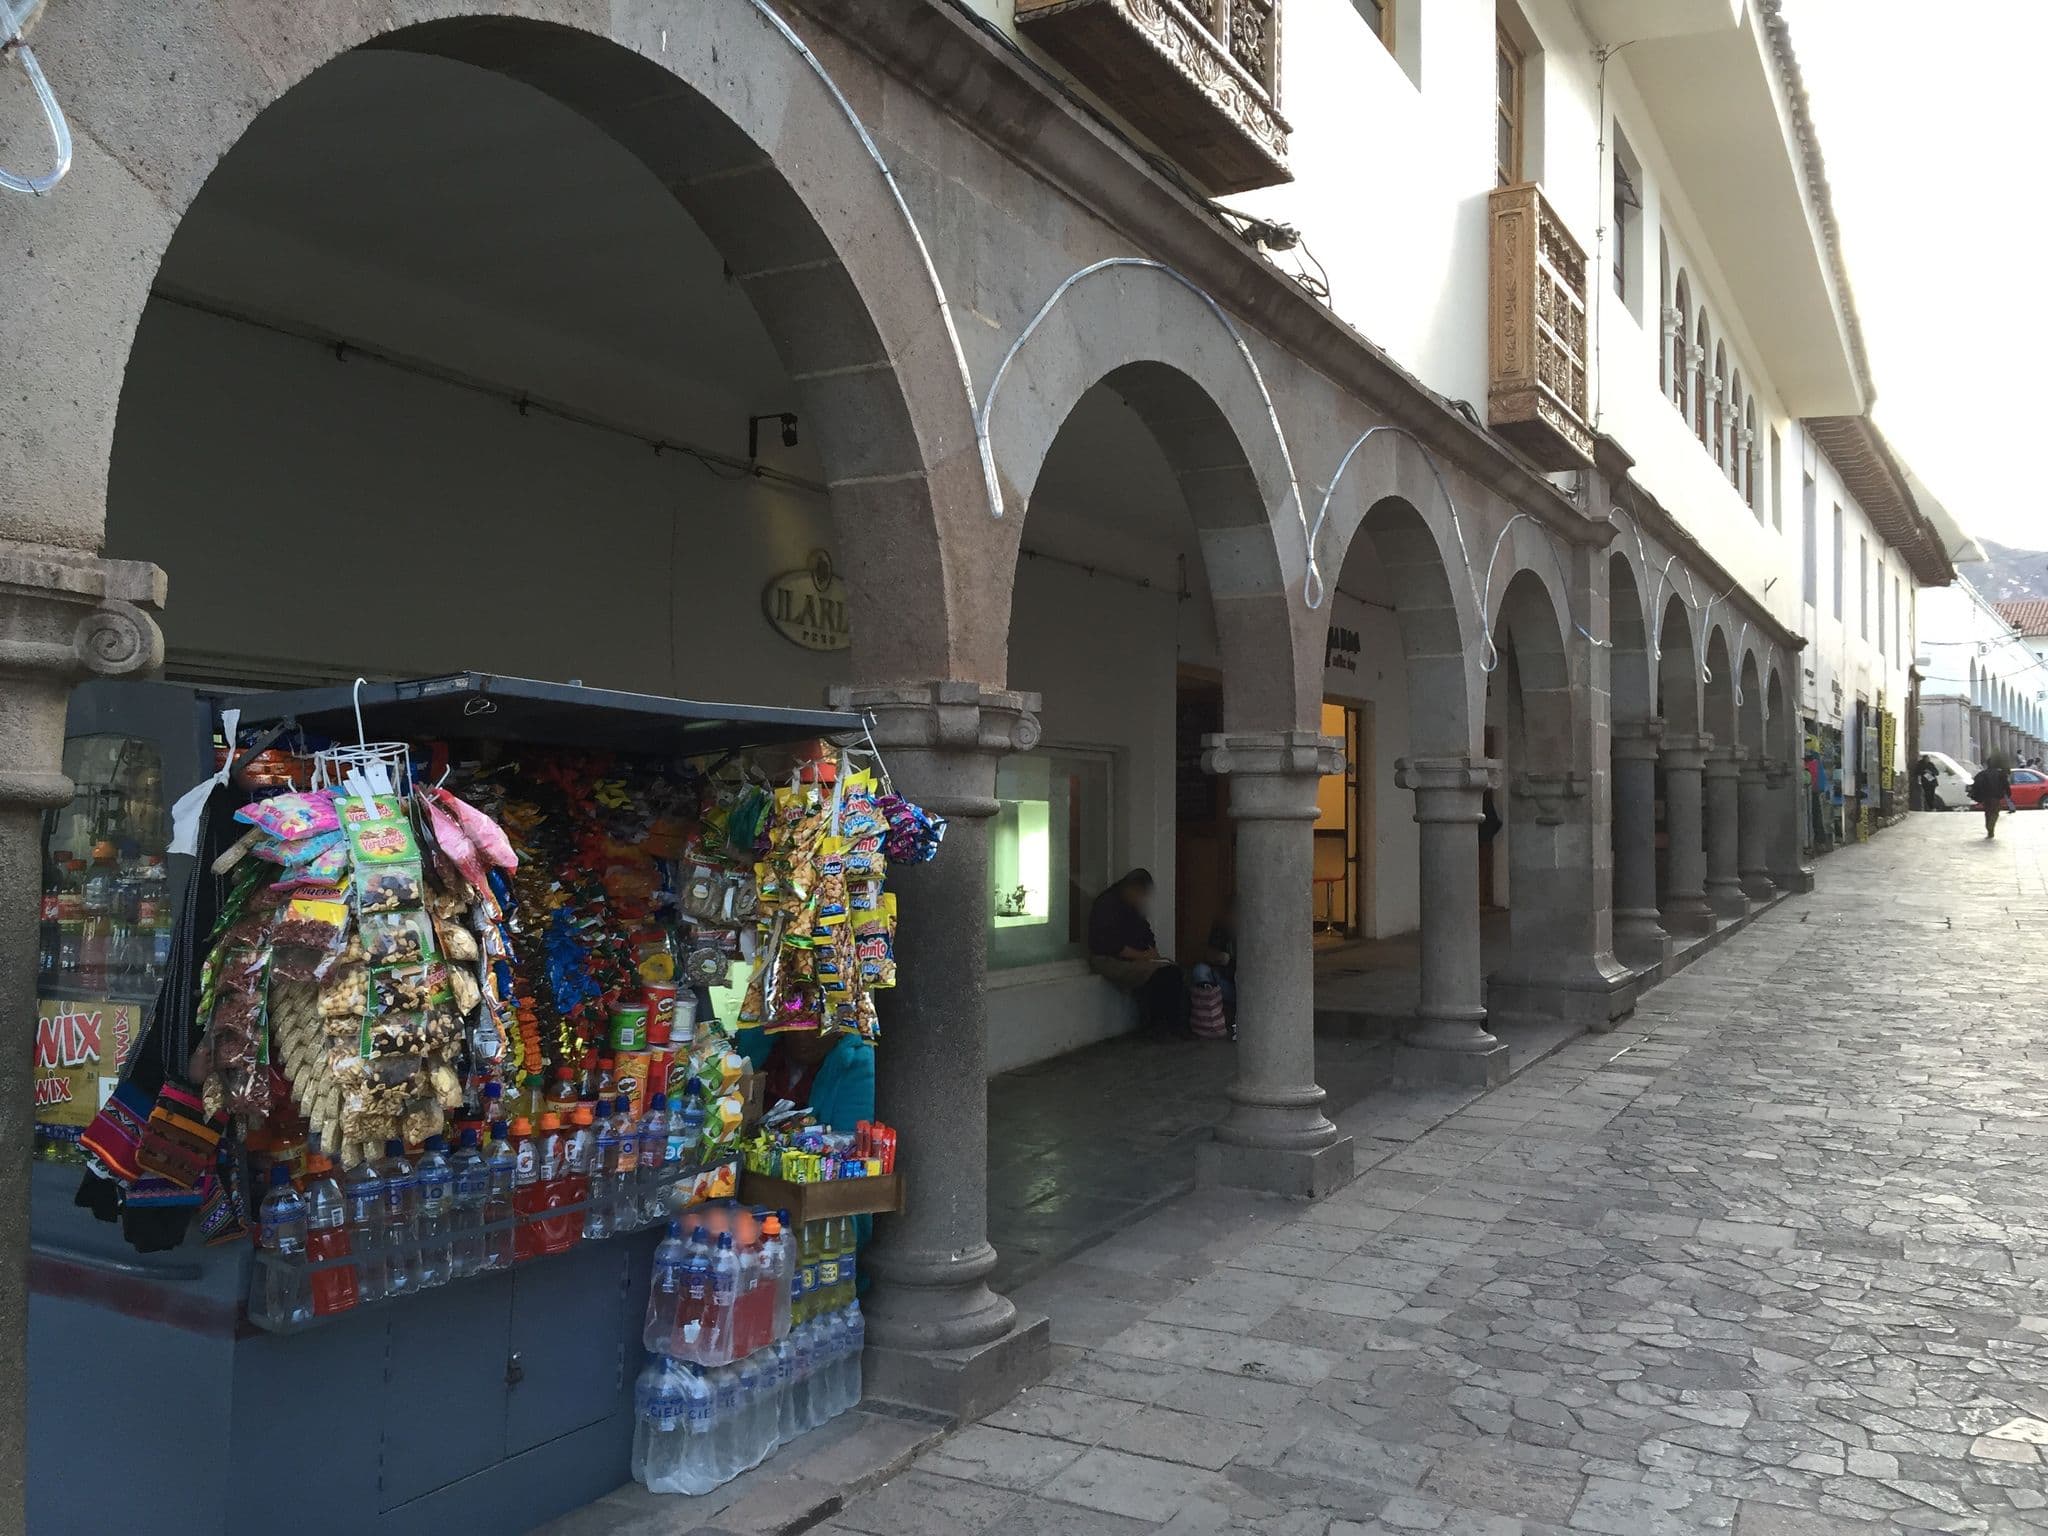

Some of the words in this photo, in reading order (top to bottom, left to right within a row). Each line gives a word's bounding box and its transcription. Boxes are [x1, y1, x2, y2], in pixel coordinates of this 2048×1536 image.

[776, 588, 848, 634] ILARI
[34, 1001, 102, 1068] WIX
[35, 1070, 73, 1106] WIX
